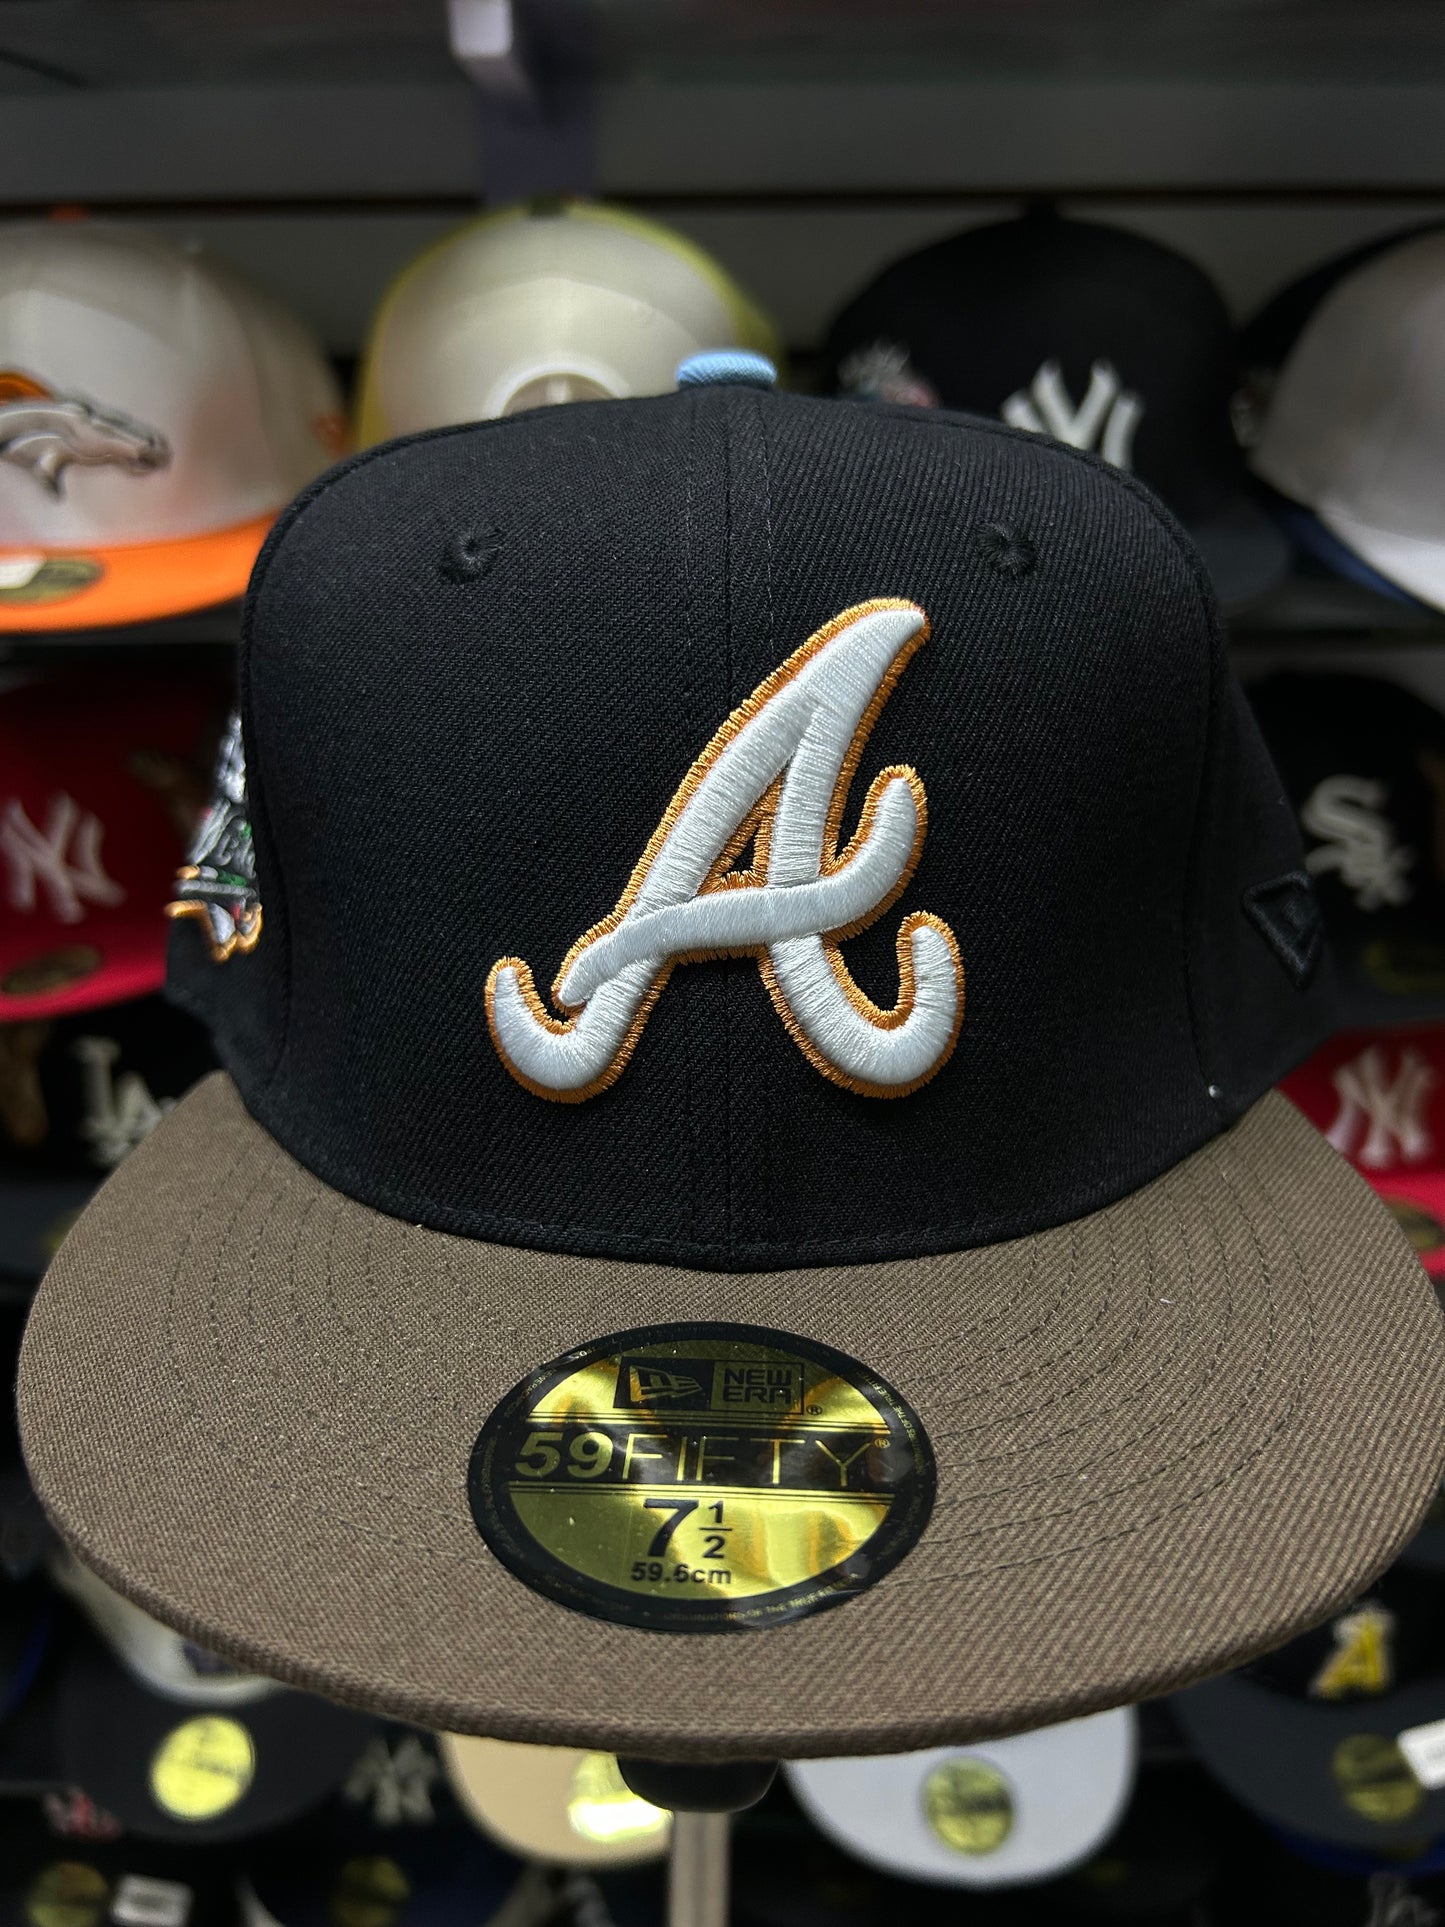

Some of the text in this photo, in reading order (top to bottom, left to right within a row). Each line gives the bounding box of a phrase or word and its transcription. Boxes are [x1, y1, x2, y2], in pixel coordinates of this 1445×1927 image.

[485, 597, 966, 1103] A
[724, 1367, 792, 1387] NEW
[723, 1386, 792, 1405] ERA
[643, 1498, 699, 1557] 7
[631, 1562, 732, 1584] 59.6cm
